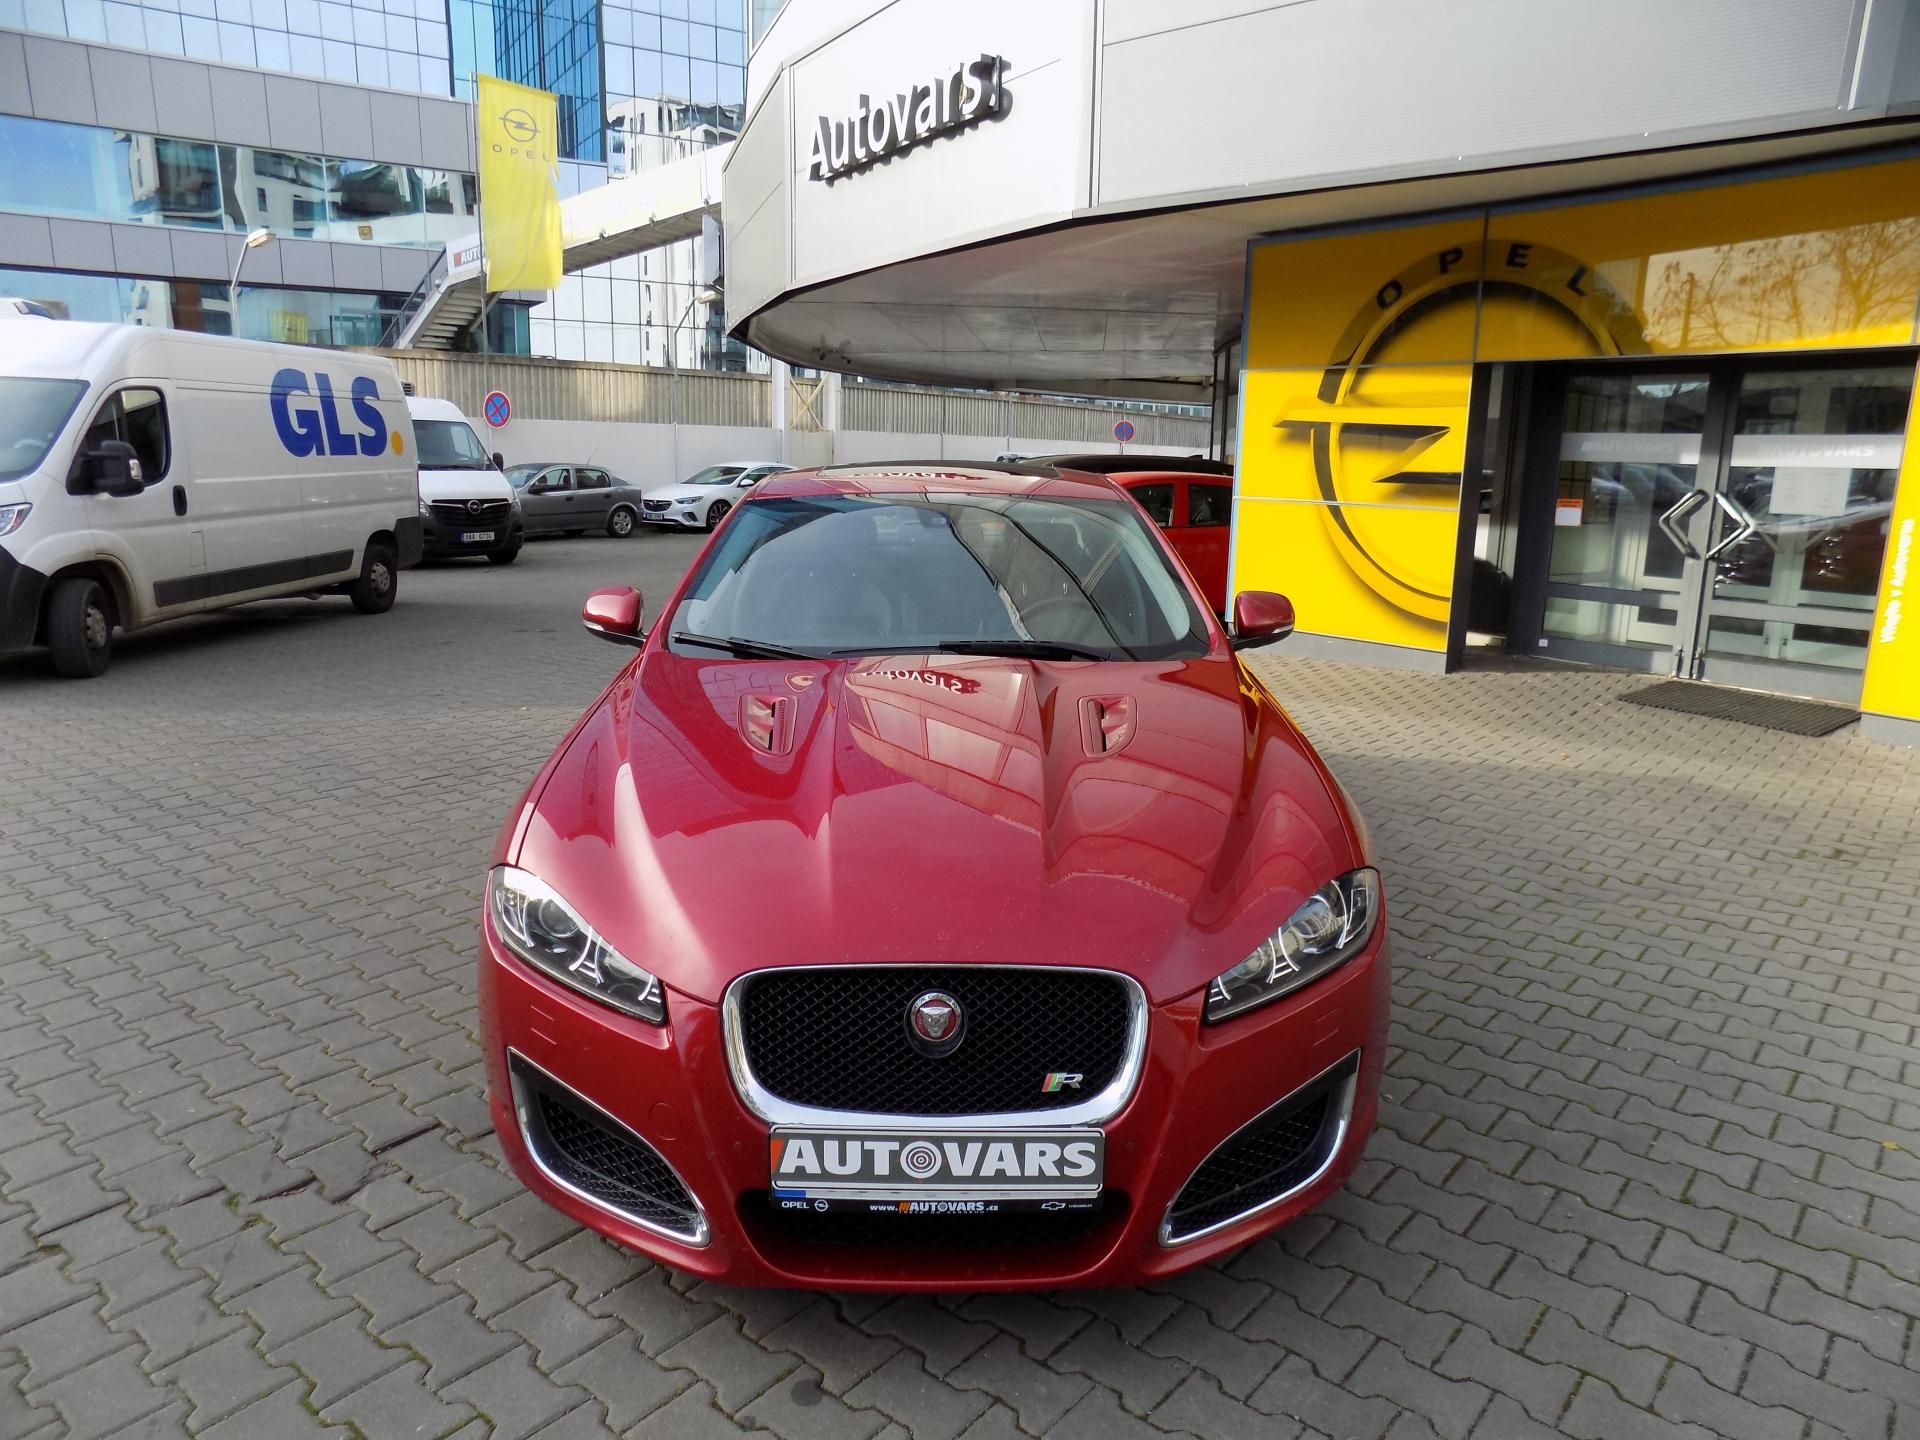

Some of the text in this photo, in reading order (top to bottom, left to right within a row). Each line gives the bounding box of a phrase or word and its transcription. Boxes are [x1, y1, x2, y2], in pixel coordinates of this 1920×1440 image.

[492, 144, 551, 162] OPEL
[1376, 242, 1588, 310] OPEL
[779, 1138, 1097, 1179] AUTOVARS
[781, 1201, 810, 1209] OPEL
